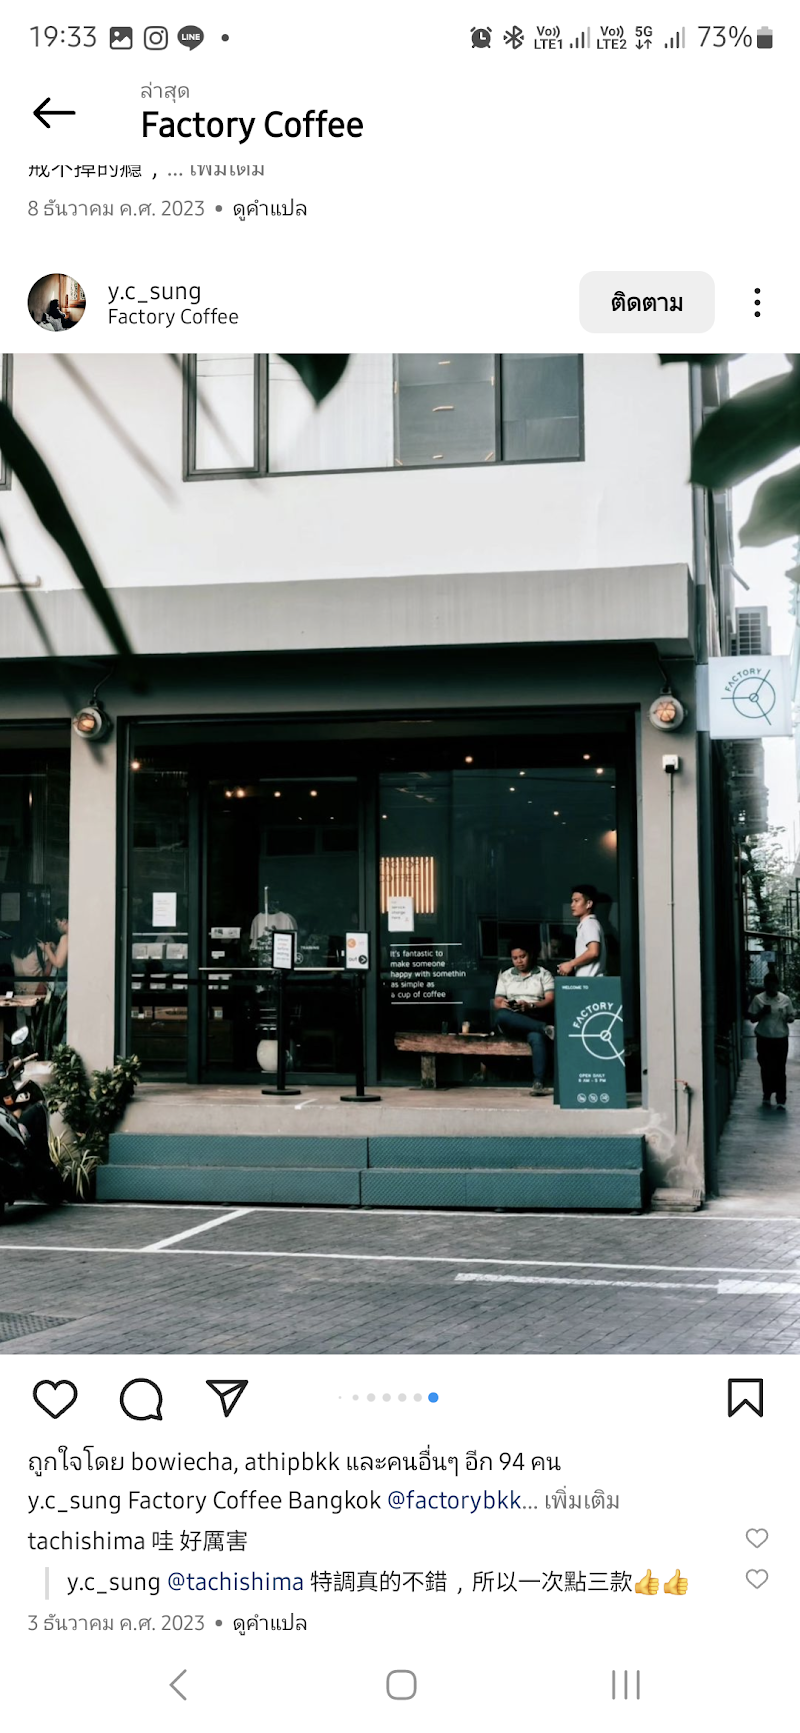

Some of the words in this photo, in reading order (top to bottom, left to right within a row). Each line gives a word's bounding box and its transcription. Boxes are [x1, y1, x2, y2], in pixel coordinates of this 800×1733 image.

[29, 25, 97, 48] 19:33
[181, 33, 200, 41] LINE
[635, 26, 653, 37] 5G
[697, 25, 753, 48] 73%
[534, 38, 563, 50] LTE1
[596, 38, 627, 50] LTE2
[140, 81, 190, 103] ล่าสุด
[142, 111, 257, 145] Factory
[264, 110, 364, 139] Coffee
[28, 201, 39, 217] 8
[44, 198, 114, 217] ธันวาคม
[119, 202, 156, 217] ค.ศ.
[161, 200, 205, 217] 2023
[233, 197, 307, 222] ดูคำแปล
[107, 284, 201, 305] y.c_sung
[611, 290, 683, 312] ติดตาม
[108, 308, 176, 328] Factory
[180, 307, 239, 325] Coffee
[725, 668, 762, 692] FACTORY
[390, 960, 410, 968] make
[390, 970, 413, 979] happy
[397, 991, 411, 999] cup
[412, 990, 421, 998] of
[422, 990, 447, 998] coffee
[400, 981, 424, 989] simple
[572, 1001, 614, 1029] FACTORY
[28, 1444, 124, 1476] ถูกใจโดย
[131, 1451, 239, 1475] bowiecha,
[244, 1451, 340, 1476] athipbkk
[346, 1443, 459, 1477] และคนอื่นๆ
[465, 1449, 493, 1471] อีก
[499, 1451, 526, 1471] 94
[531, 1455, 562, 1471] คน
[27, 1493, 121, 1515] y.c_sung
[129, 1490, 207, 1515] Factory
[213, 1489, 282, 1510] Coffee
[289, 1490, 382, 1515] Bangkok
[545, 1485, 619, 1510] เพิ่มเติม
[27, 1530, 145, 1551] tachishima
[152, 1529, 174, 1551] 哇
[179, 1529, 248, 1552] 好厲害
[67, 1576, 160, 1596] y.c_sung
[167, 1571, 304, 1592] @tachishima
[28, 1614, 38, 1631] 3
[44, 1612, 114, 1631] ธันวาคม
[119, 1617, 156, 1631] ค.ศ.
[161, 1614, 205, 1631] 2023
[233, 1612, 307, 1636] ดูคำแปล
